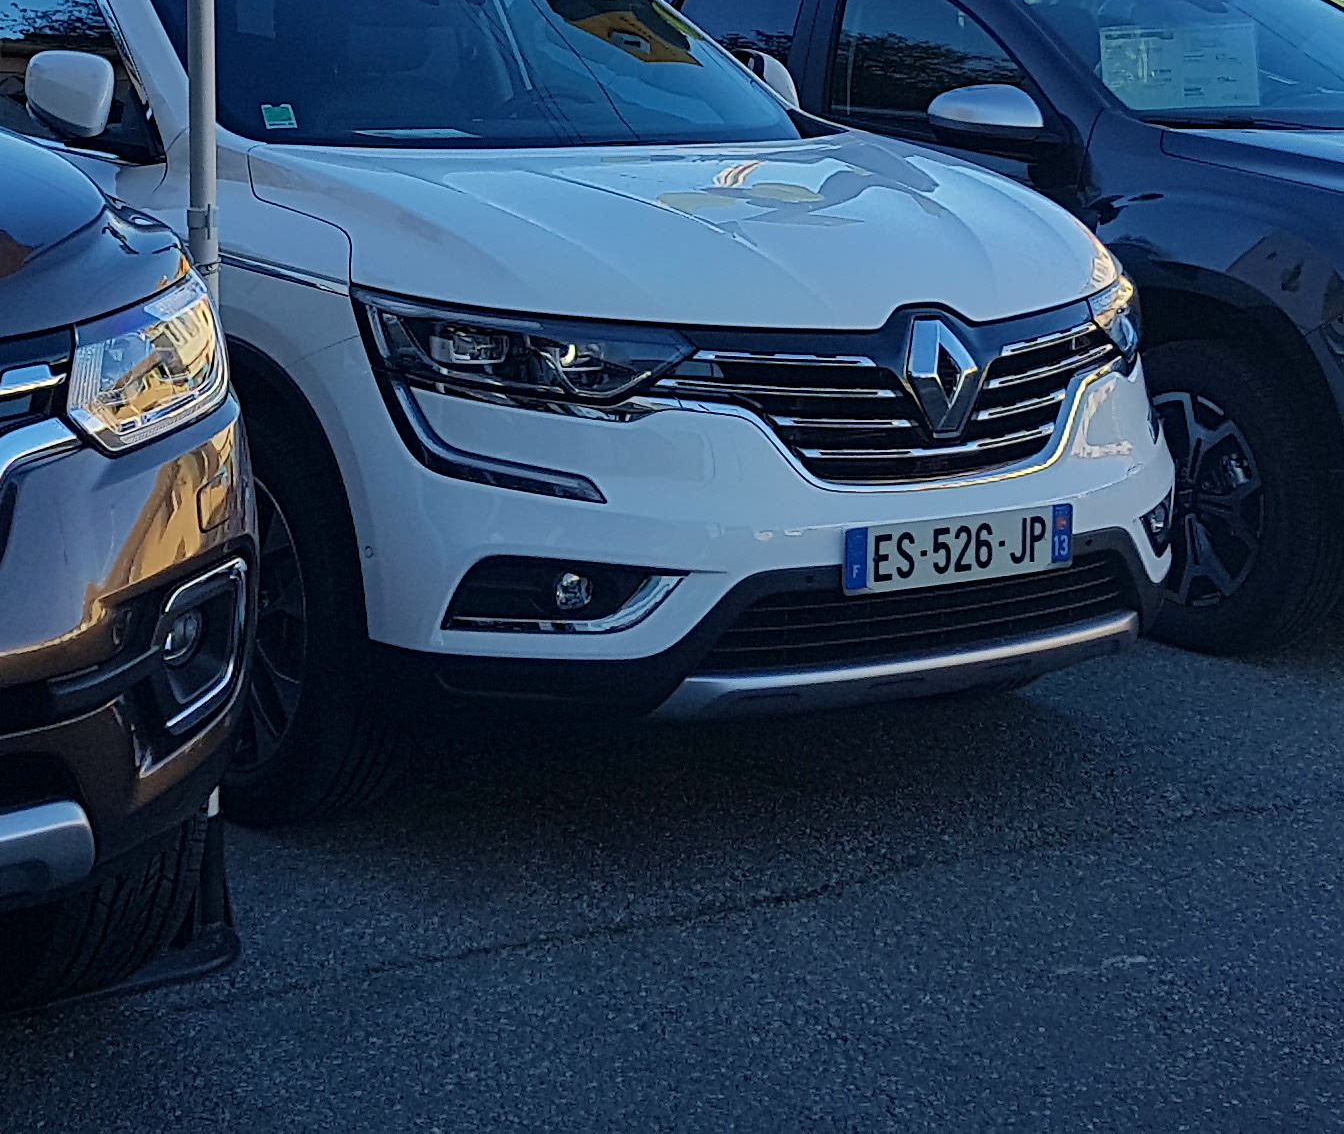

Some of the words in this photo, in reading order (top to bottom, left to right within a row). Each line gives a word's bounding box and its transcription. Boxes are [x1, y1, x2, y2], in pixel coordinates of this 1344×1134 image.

[851, 564, 861, 580] F
[872, 515, 1047, 583] ES-526-JP
[1053, 534, 1070, 556] 13
